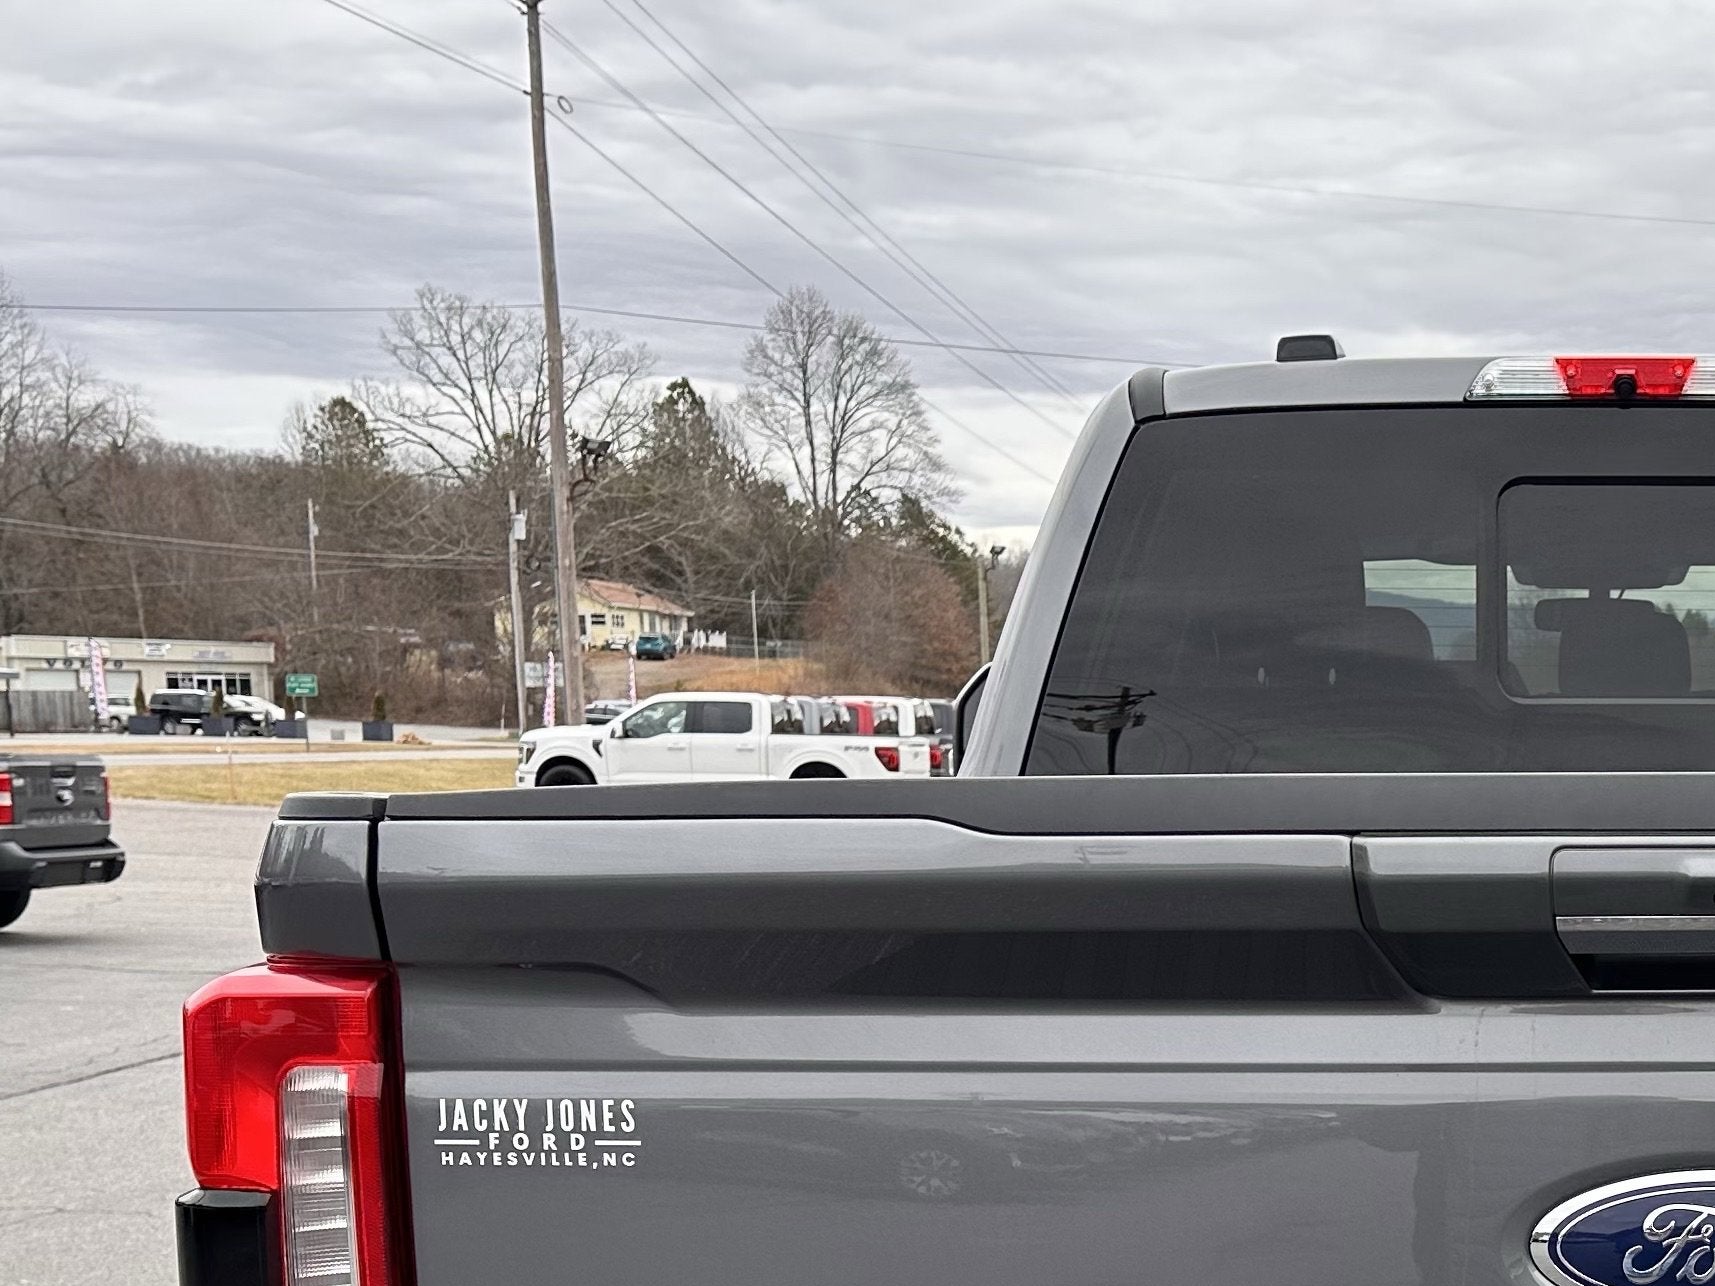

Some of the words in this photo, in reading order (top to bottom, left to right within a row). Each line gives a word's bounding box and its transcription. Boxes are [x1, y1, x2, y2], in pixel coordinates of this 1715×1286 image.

[438, 1099, 529, 1132] JACKY
[544, 1099, 636, 1133] JONES
[488, 1132, 587, 1151] FORD
